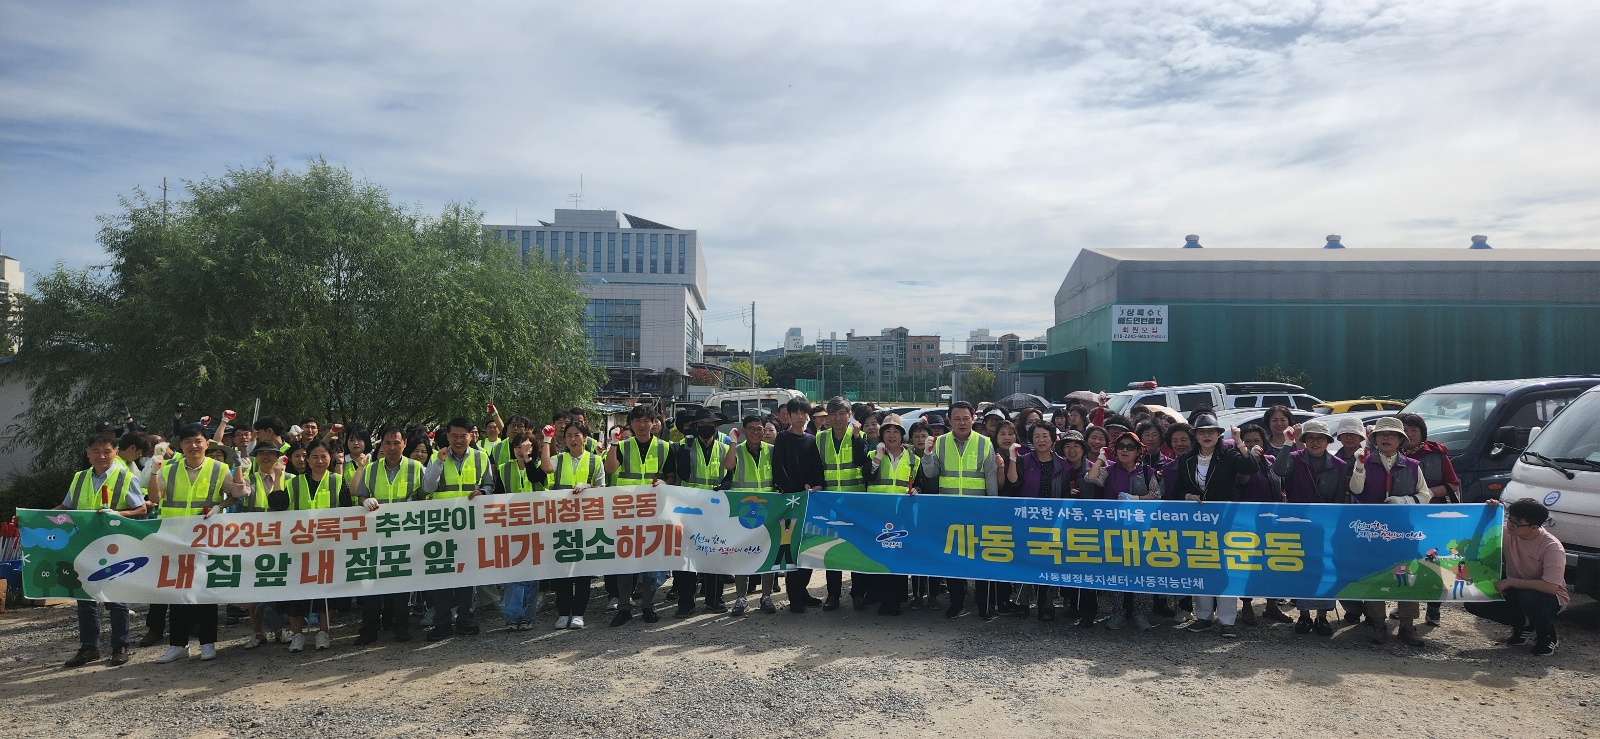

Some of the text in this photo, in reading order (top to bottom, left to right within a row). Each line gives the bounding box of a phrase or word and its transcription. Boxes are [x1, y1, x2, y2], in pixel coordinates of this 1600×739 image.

[191, 493, 657, 548] 2023년 상록구 추석맞이 국토대청결 운동
[1014, 506, 1220, 525] 깨끗한 사동, 우리마을 clean day
[1405, 530, 1426, 540] 안산
[744, 545, 764, 554] 안산
[881, 541, 902, 549] 안산시
[944, 524, 1305, 572] 사동 국토대청결운동
[157, 524, 683, 589] 내 집 앞 내 점포 앞, 내가 청소하기!
